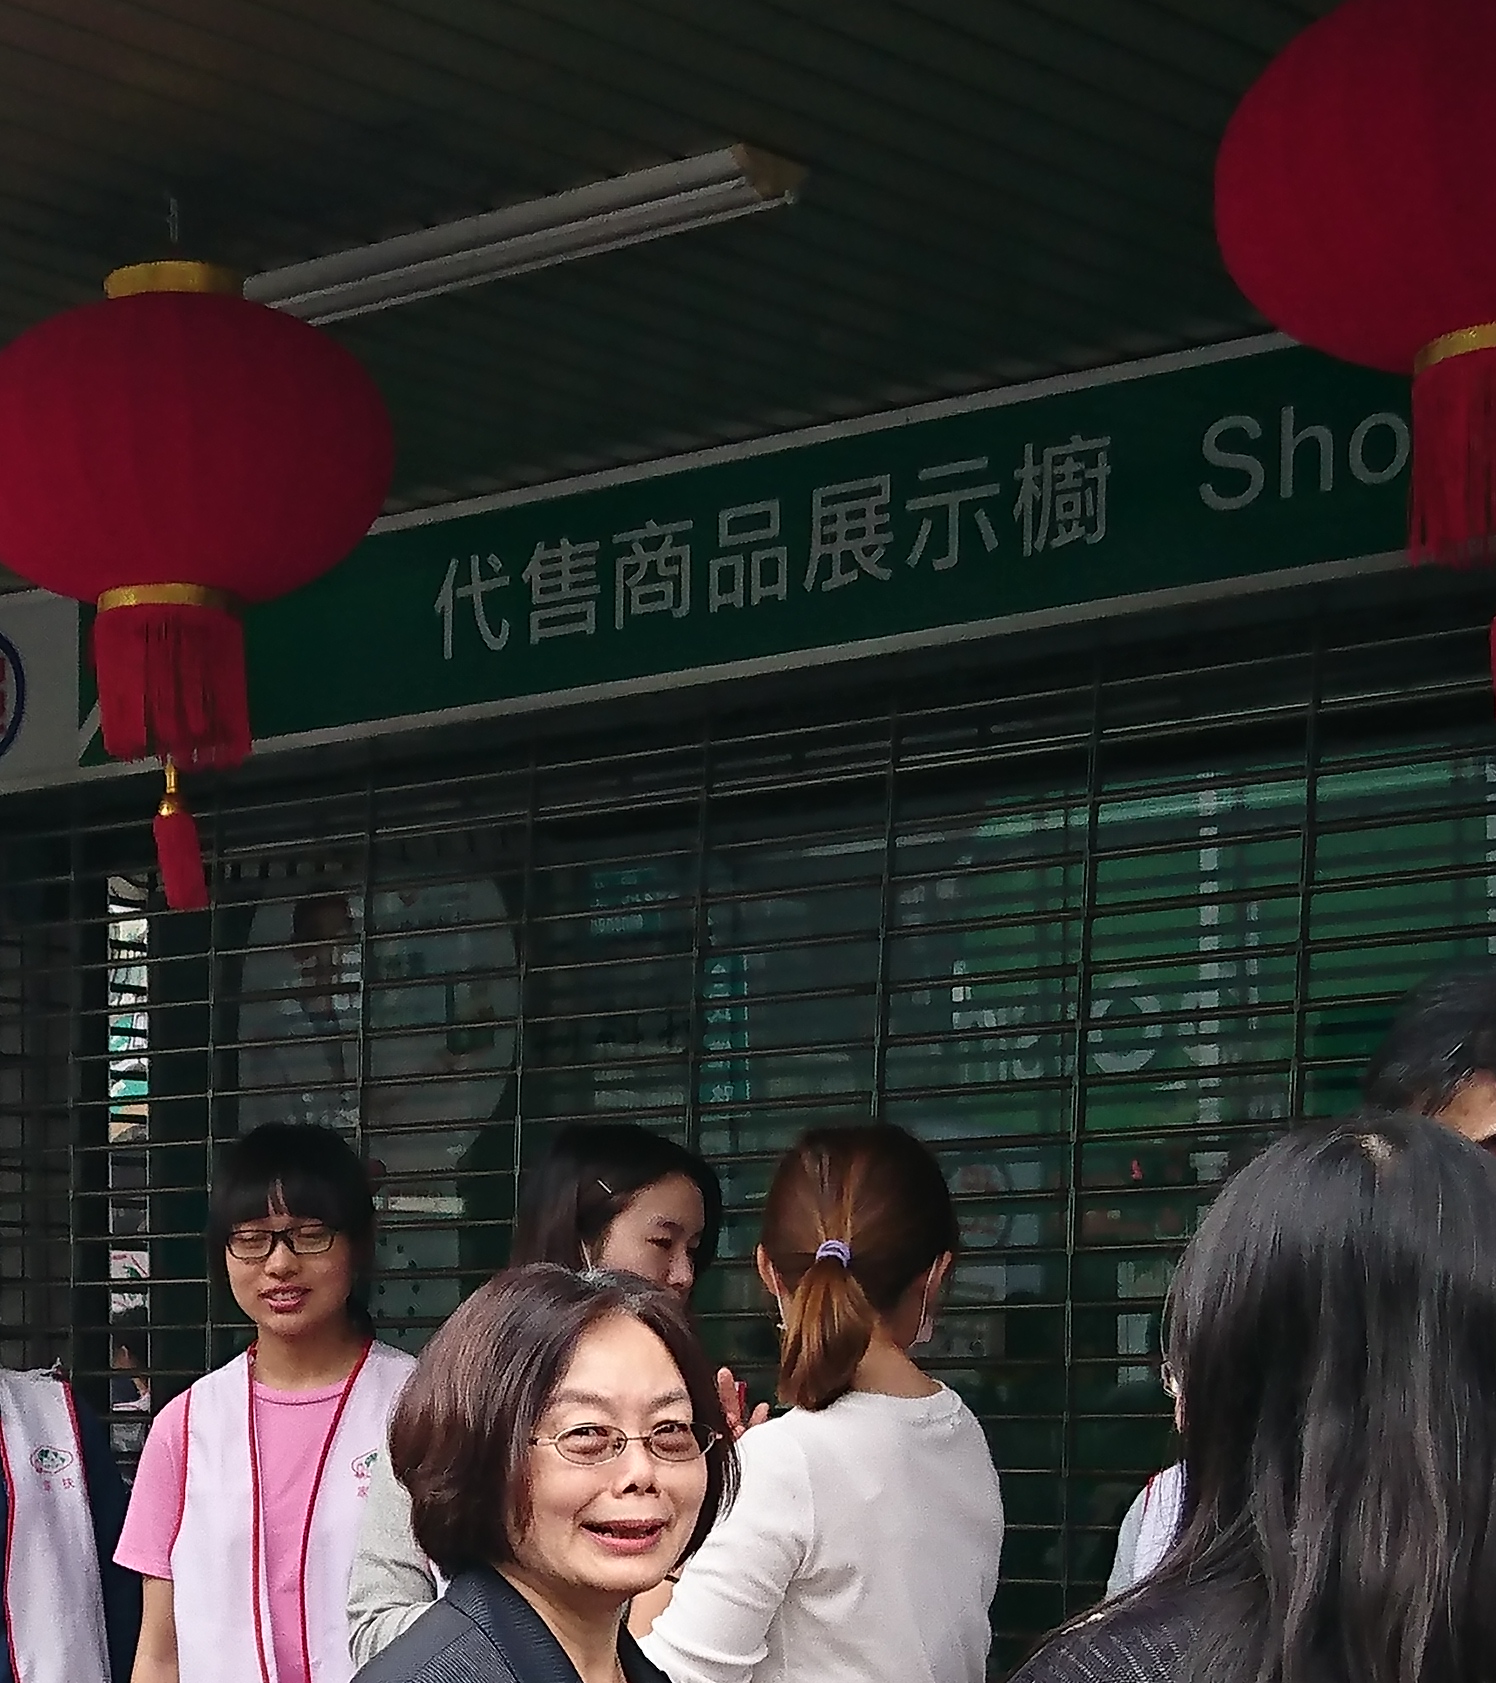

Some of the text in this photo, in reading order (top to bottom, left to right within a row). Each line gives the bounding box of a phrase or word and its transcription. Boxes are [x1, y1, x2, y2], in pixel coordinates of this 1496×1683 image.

[434, 435, 1112, 660] 代售商品展示櫥
